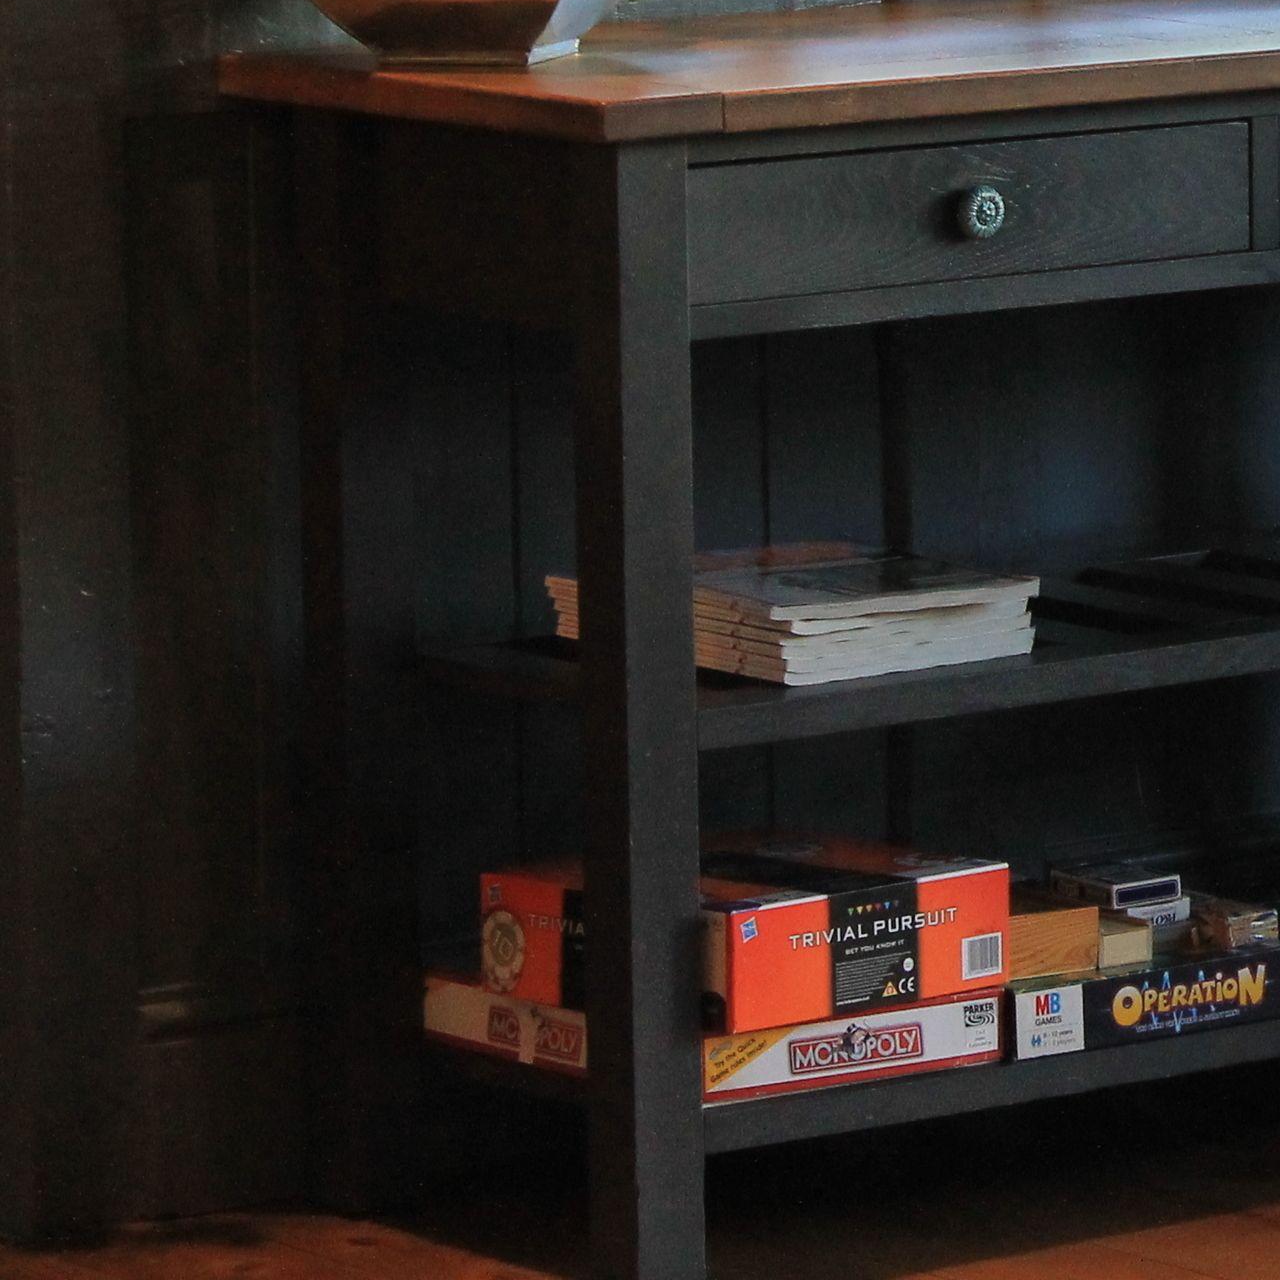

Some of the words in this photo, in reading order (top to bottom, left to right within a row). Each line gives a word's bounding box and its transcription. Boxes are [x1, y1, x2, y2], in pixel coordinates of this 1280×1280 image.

[528, 914, 585, 936] TRIVIA
[789, 924, 869, 950] TRIVIAL
[873, 907, 958, 936] PURSUIT
[845, 947, 859, 956] BET
[876, 940, 896, 949] KNOW
[897, 938, 905, 946] IT
[963, 1002, 994, 1014] PARKER
[1035, 992, 1061, 1017] MB
[1035, 1015, 1062, 1026] GAMES
[492, 1017, 579, 1052] MOPOLY
[795, 1029, 918, 1068] MONOPOLY
